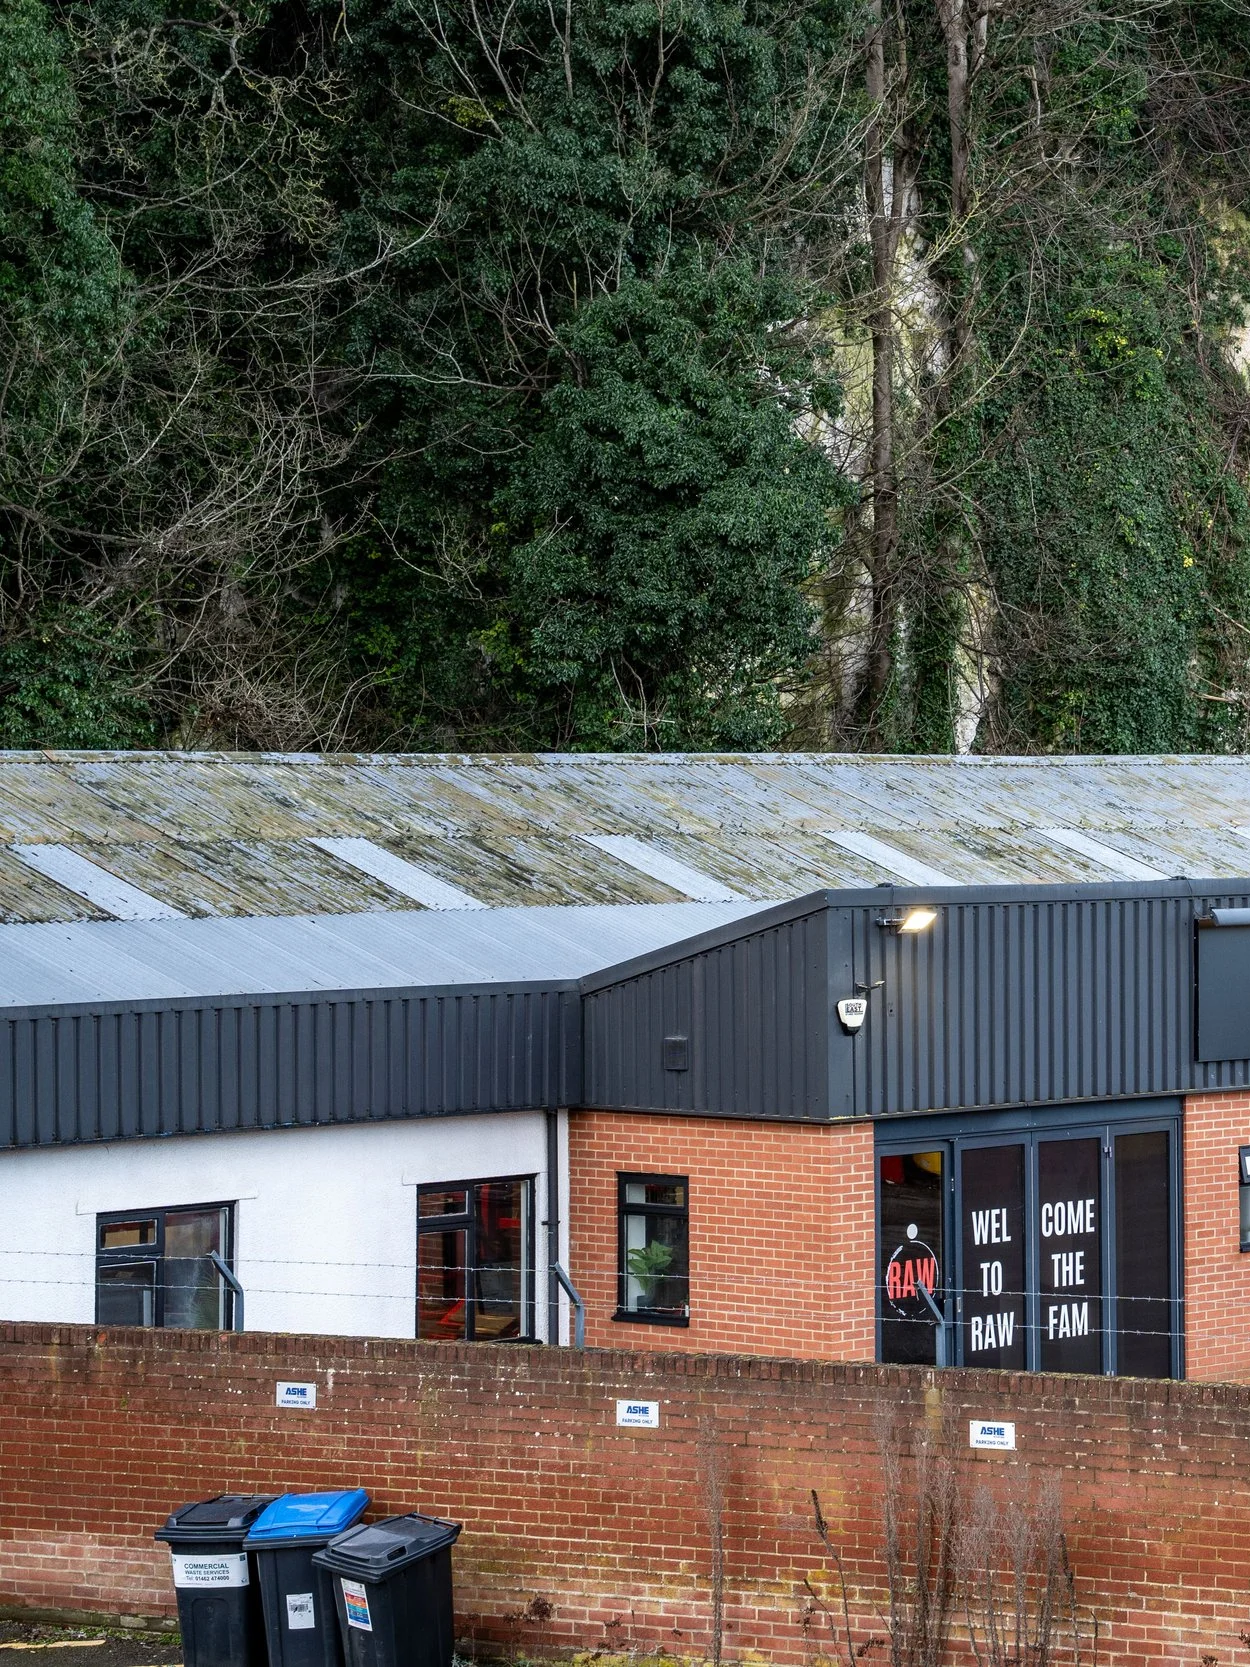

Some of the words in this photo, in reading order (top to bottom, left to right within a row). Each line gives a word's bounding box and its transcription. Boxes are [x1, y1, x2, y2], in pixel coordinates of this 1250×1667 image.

[971, 1207, 1011, 1246] WEL
[1041, 1198, 1095, 1238] COME
[889, 1258, 935, 1299] RAW
[980, 1261, 1002, 1297] TO
[1051, 1250, 1085, 1288] THE
[971, 1311, 1014, 1352] RAW
[1048, 1301, 1089, 1340] FAM
[285, 1387, 307, 1396] ASHE
[626, 1405, 649, 1414] ASHE
[980, 1426, 1005, 1436] ASHE
